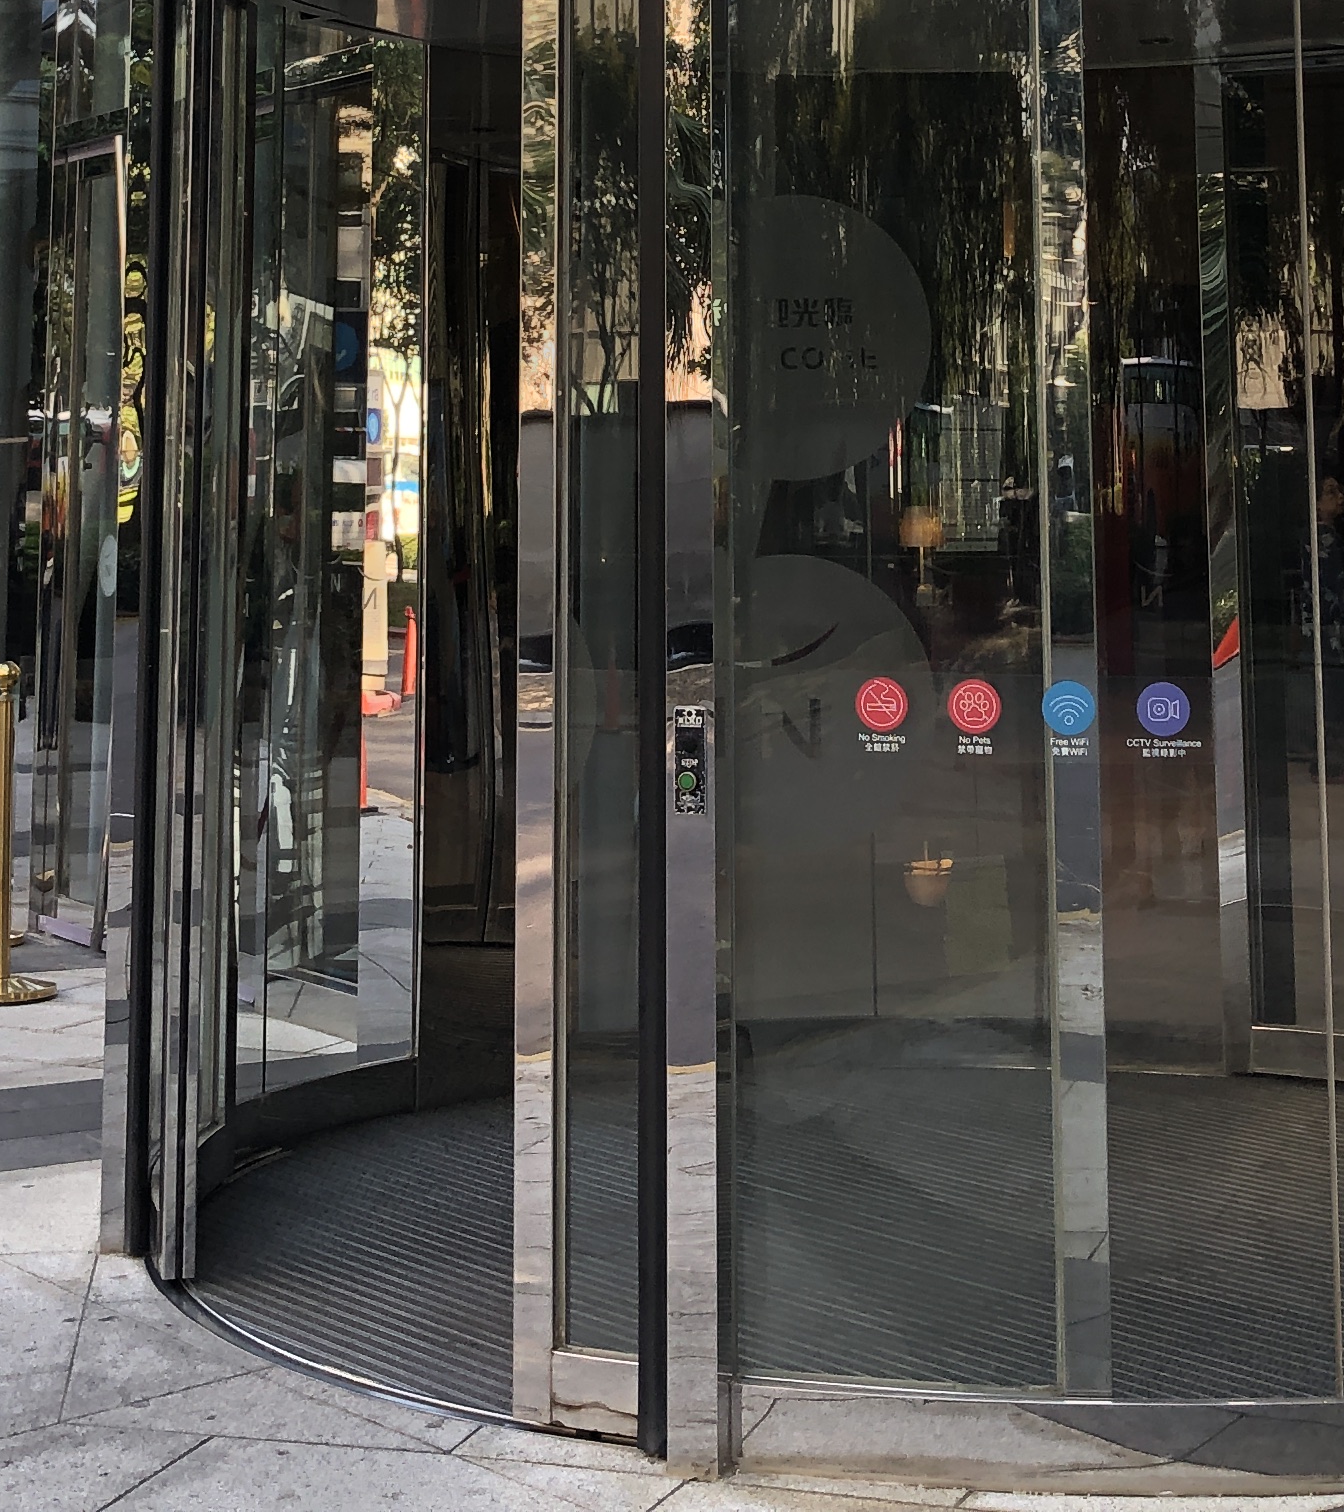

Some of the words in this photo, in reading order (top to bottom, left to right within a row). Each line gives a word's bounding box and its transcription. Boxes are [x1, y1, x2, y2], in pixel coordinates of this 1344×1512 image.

[858, 732, 870, 742] No
[871, 732, 906, 744] Smoking
[959, 735, 971, 744] No
[973, 735, 992, 745] Pets
[1050, 737, 1069, 746] Free
[1070, 737, 1089, 746] WiFi
[1126, 738, 1151, 747] CCTV
[1152, 738, 1202, 748] Surveillance
